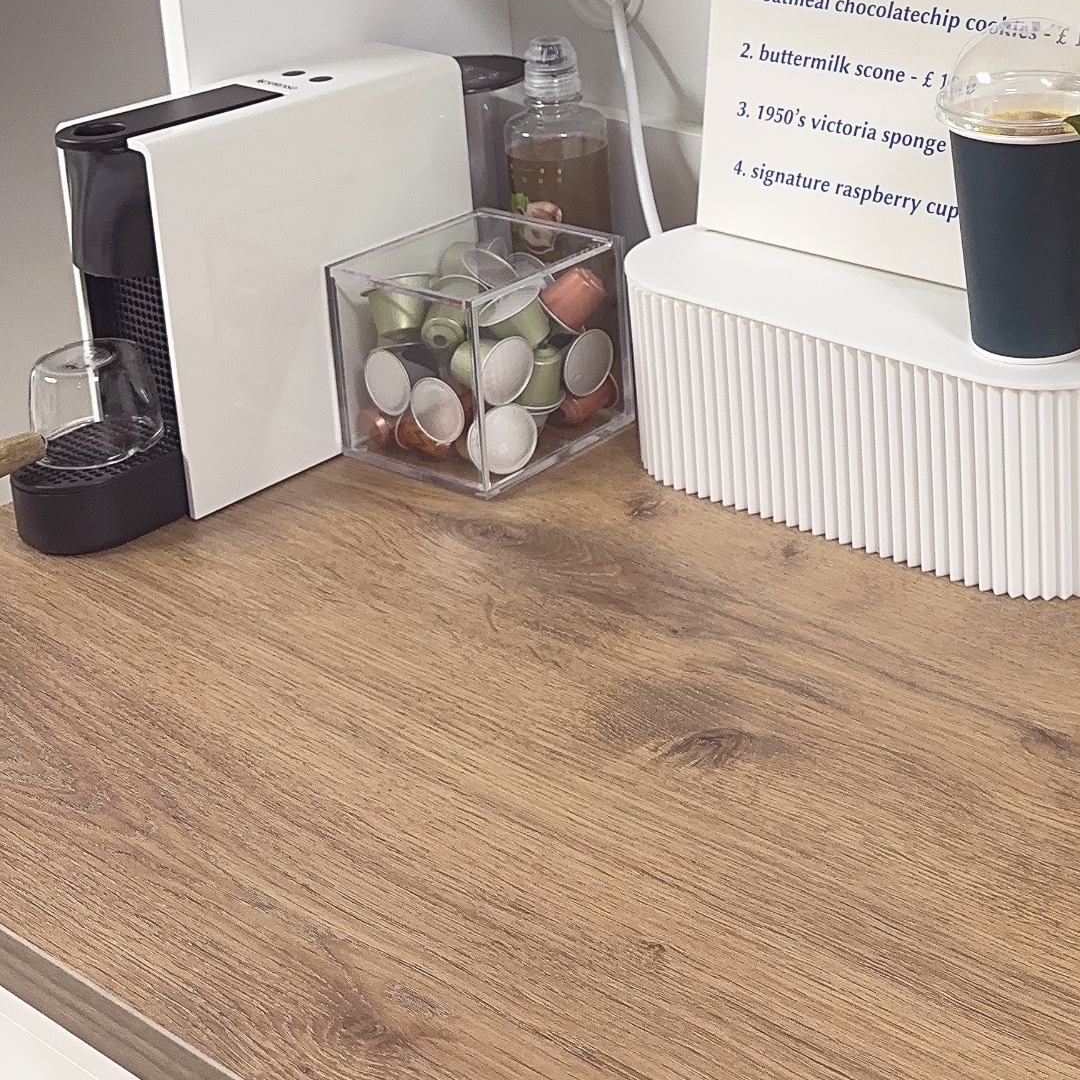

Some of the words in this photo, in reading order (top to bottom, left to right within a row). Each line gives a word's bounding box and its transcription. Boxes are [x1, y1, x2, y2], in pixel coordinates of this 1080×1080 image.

[739, 42, 754, 59] 2.
[758, 43, 851, 75] buttermilk
[854, 64, 906, 83] scone
[922, 70, 935, 88] £
[736, 101, 750, 119] 3.
[811, 114, 877, 141] victoria
[881, 129, 947, 156] sponge
[733, 160, 746, 177] 4.
[750, 163, 831, 193] signature
[835, 185, 922, 216] raspberry
